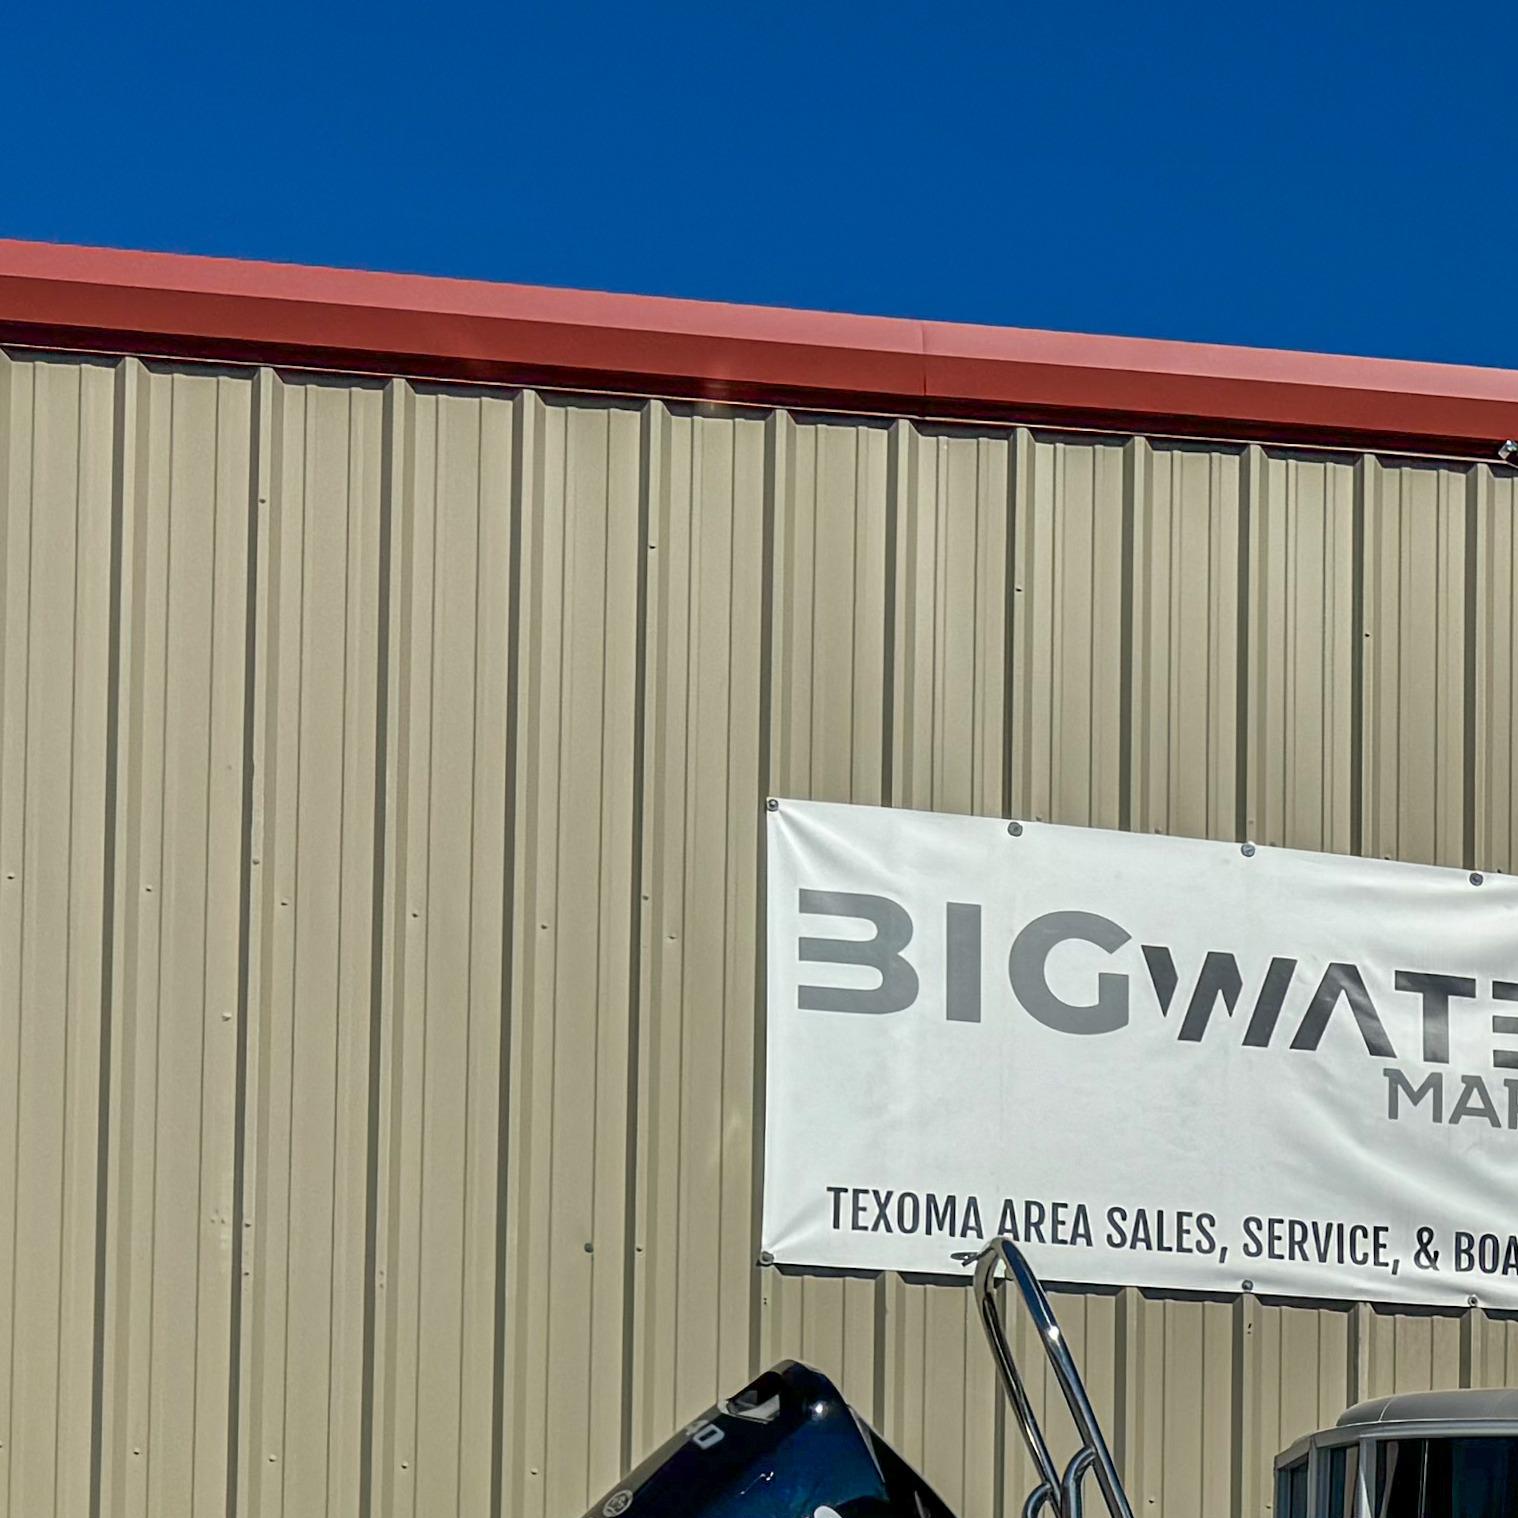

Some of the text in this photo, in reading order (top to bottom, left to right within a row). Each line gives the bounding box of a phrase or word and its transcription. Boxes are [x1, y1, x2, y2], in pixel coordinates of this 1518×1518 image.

[826, 1186, 984, 1240] TEXOMA
[999, 1198, 1094, 1248] AREA
[1106, 1206, 1228, 1264] SALES,
[1242, 1216, 1400, 1275] SERVICE,
[1413, 1226, 1440, 1271] &
